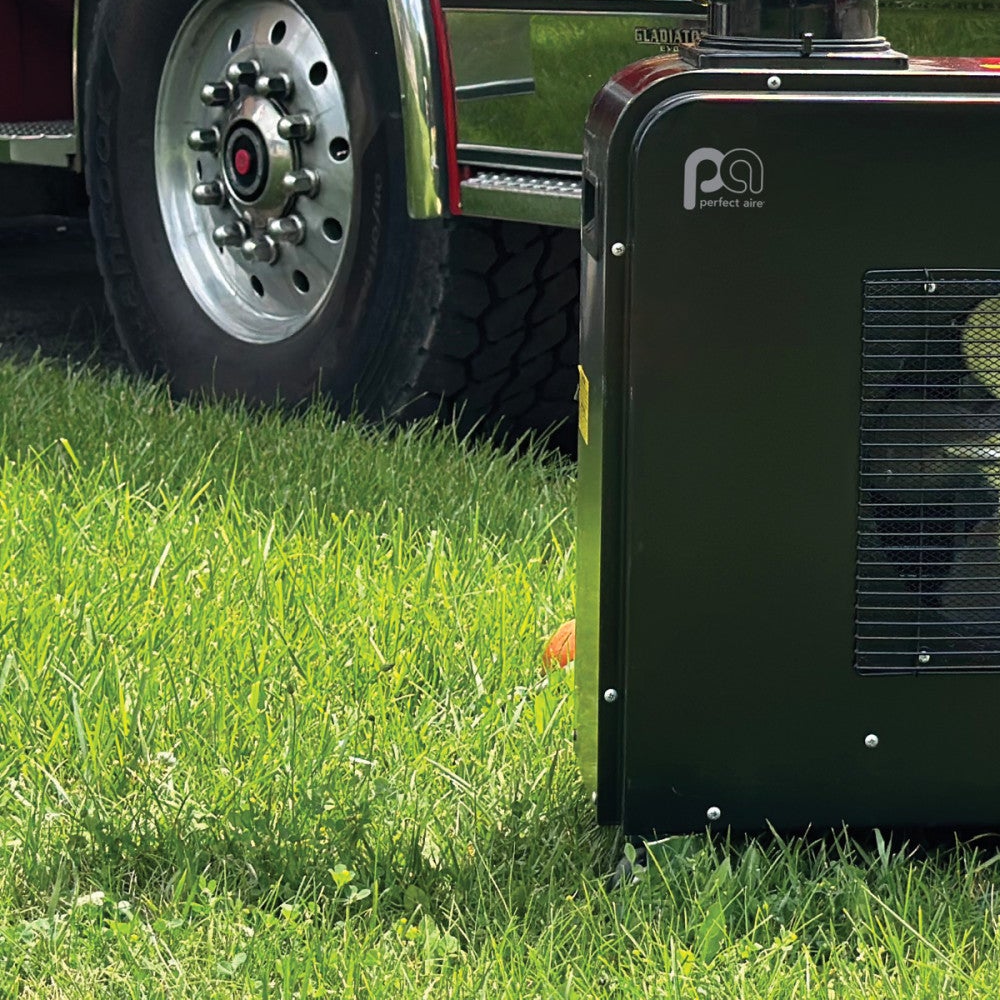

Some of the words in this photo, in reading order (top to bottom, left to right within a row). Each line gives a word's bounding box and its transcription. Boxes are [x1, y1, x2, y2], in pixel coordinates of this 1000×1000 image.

[634, 28, 702, 43] GLADIATO
[699, 196, 740, 210] perfect
[743, 198, 764, 208] aire
